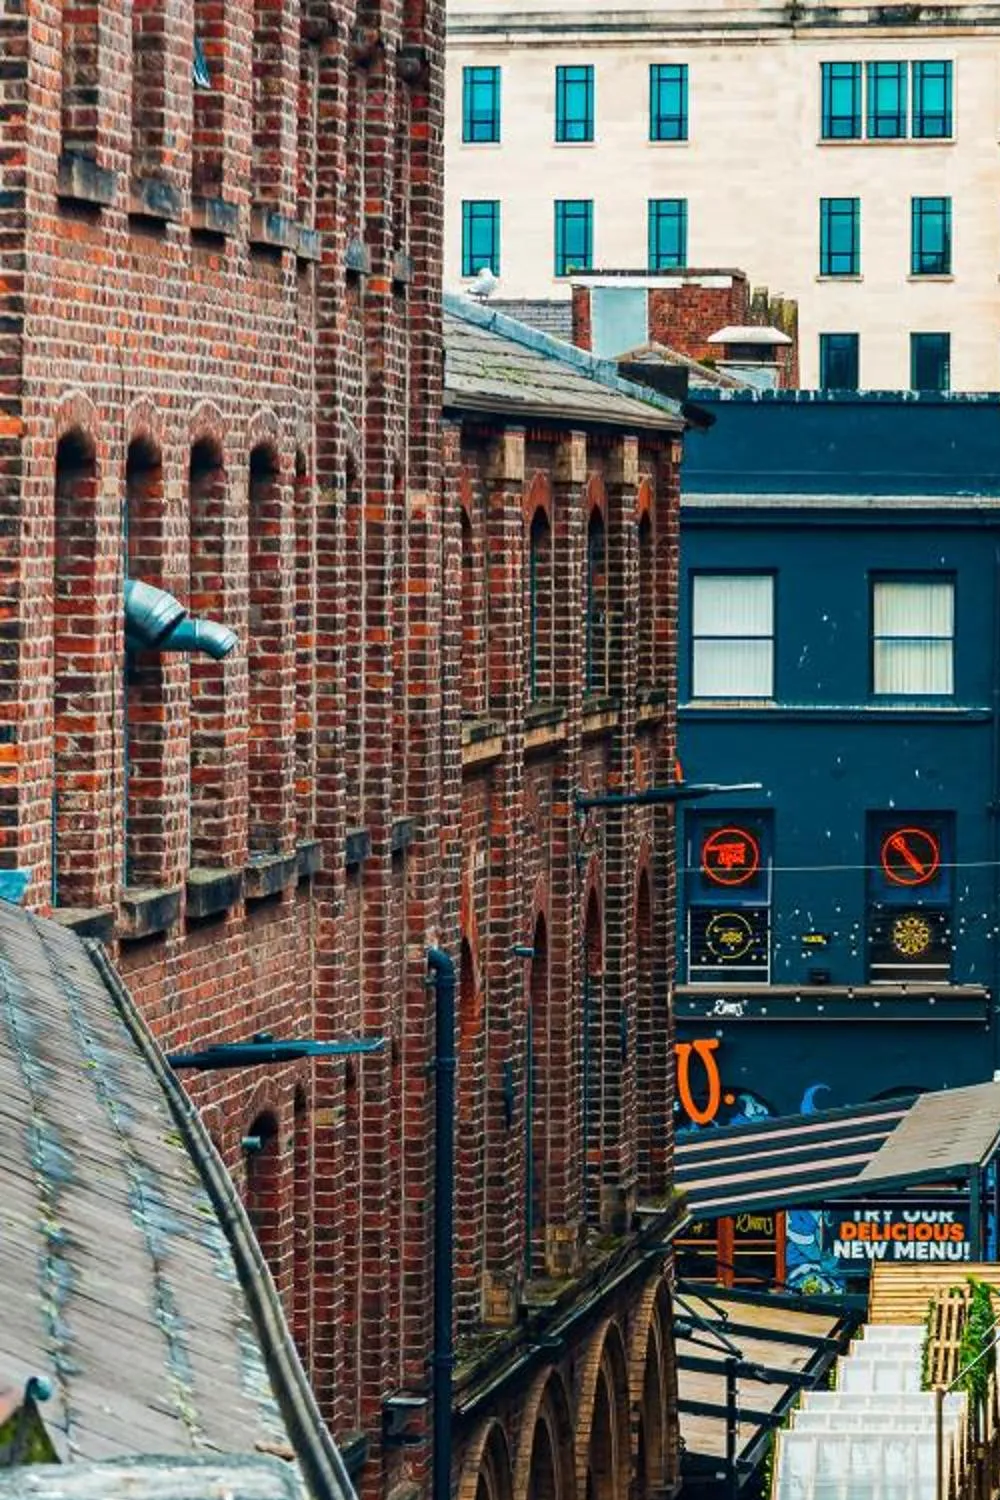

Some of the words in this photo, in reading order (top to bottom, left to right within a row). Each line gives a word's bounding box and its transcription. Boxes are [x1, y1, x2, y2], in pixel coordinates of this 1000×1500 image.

[853, 1210, 893, 1222] TRY
[903, 1210, 956, 1222] OUR
[840, 1222, 965, 1241] DELICIOUS
[833, 1240, 887, 1259] NEW
[893, 1241, 971, 1260] MENU!
